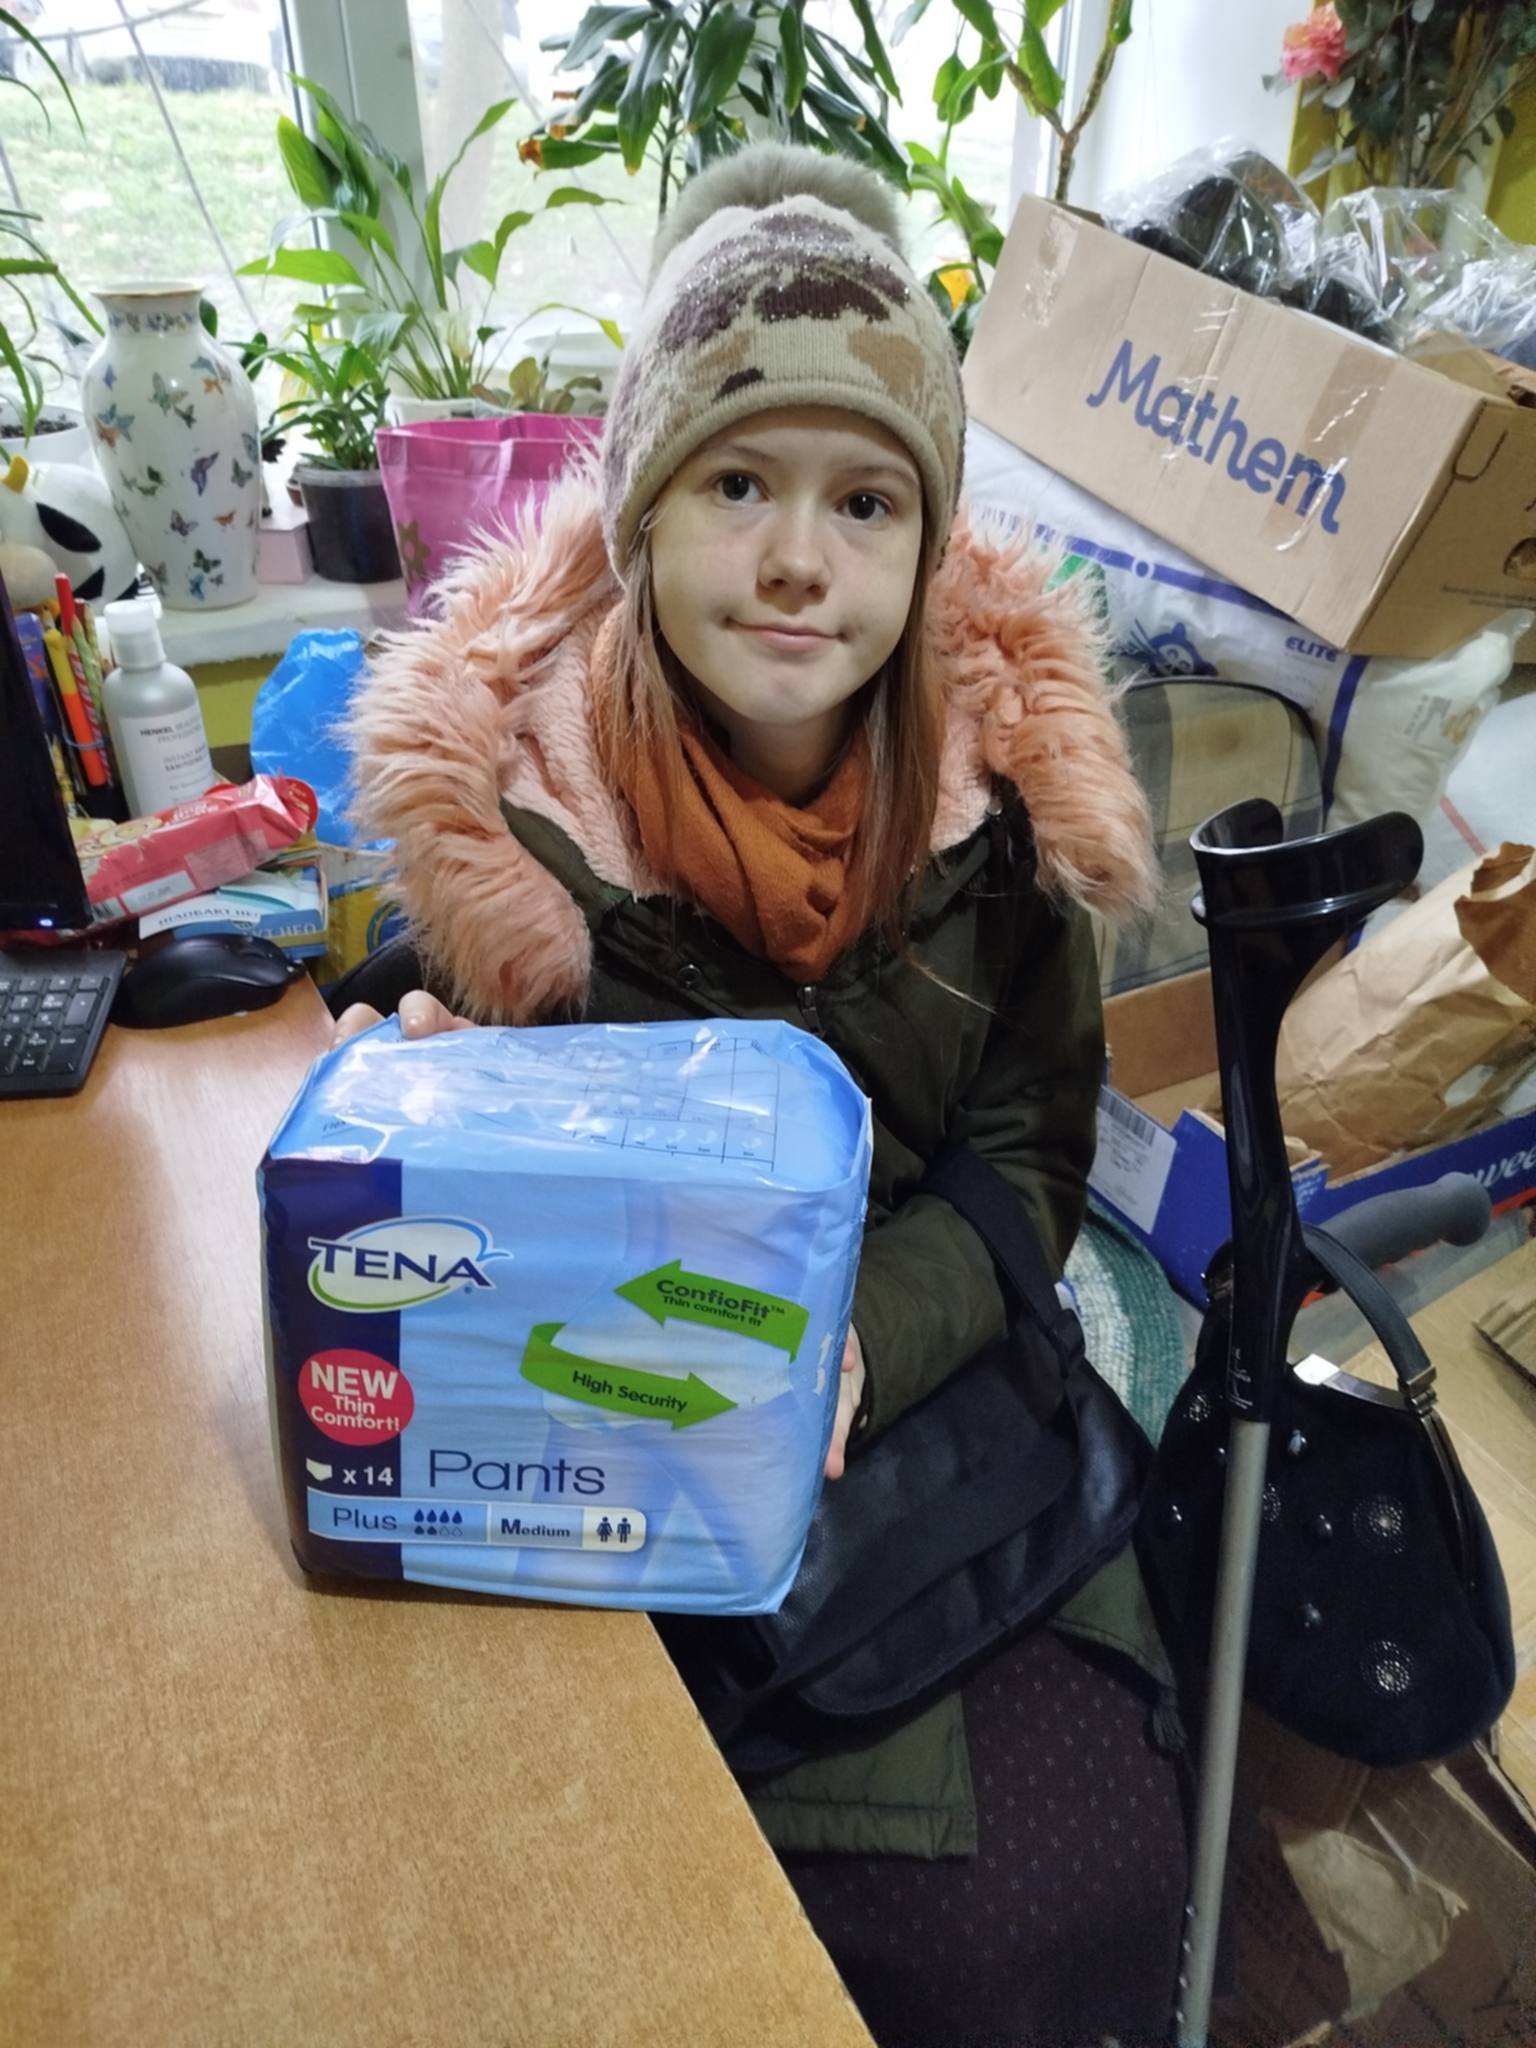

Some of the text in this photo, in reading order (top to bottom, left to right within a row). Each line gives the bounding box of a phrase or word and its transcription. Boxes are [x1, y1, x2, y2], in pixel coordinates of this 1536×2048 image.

[1086, 339, 1346, 534] Mathem
[1285, 636, 1337, 663] ELITE
[309, 1240, 493, 1288] TENA
[664, 1296, 762, 1327] Thin comfort fit
[310, 1360, 398, 1400] NEW
[572, 1369, 688, 1413] High Security
[310, 1405, 400, 1432] Comfort!
[332, 1394, 375, 1415] Thin
[363, 1467, 394, 1486] 14
[429, 1449, 606, 1495] Pants
[333, 1507, 398, 1531] Plus
[501, 1518, 571, 1538] Medium
